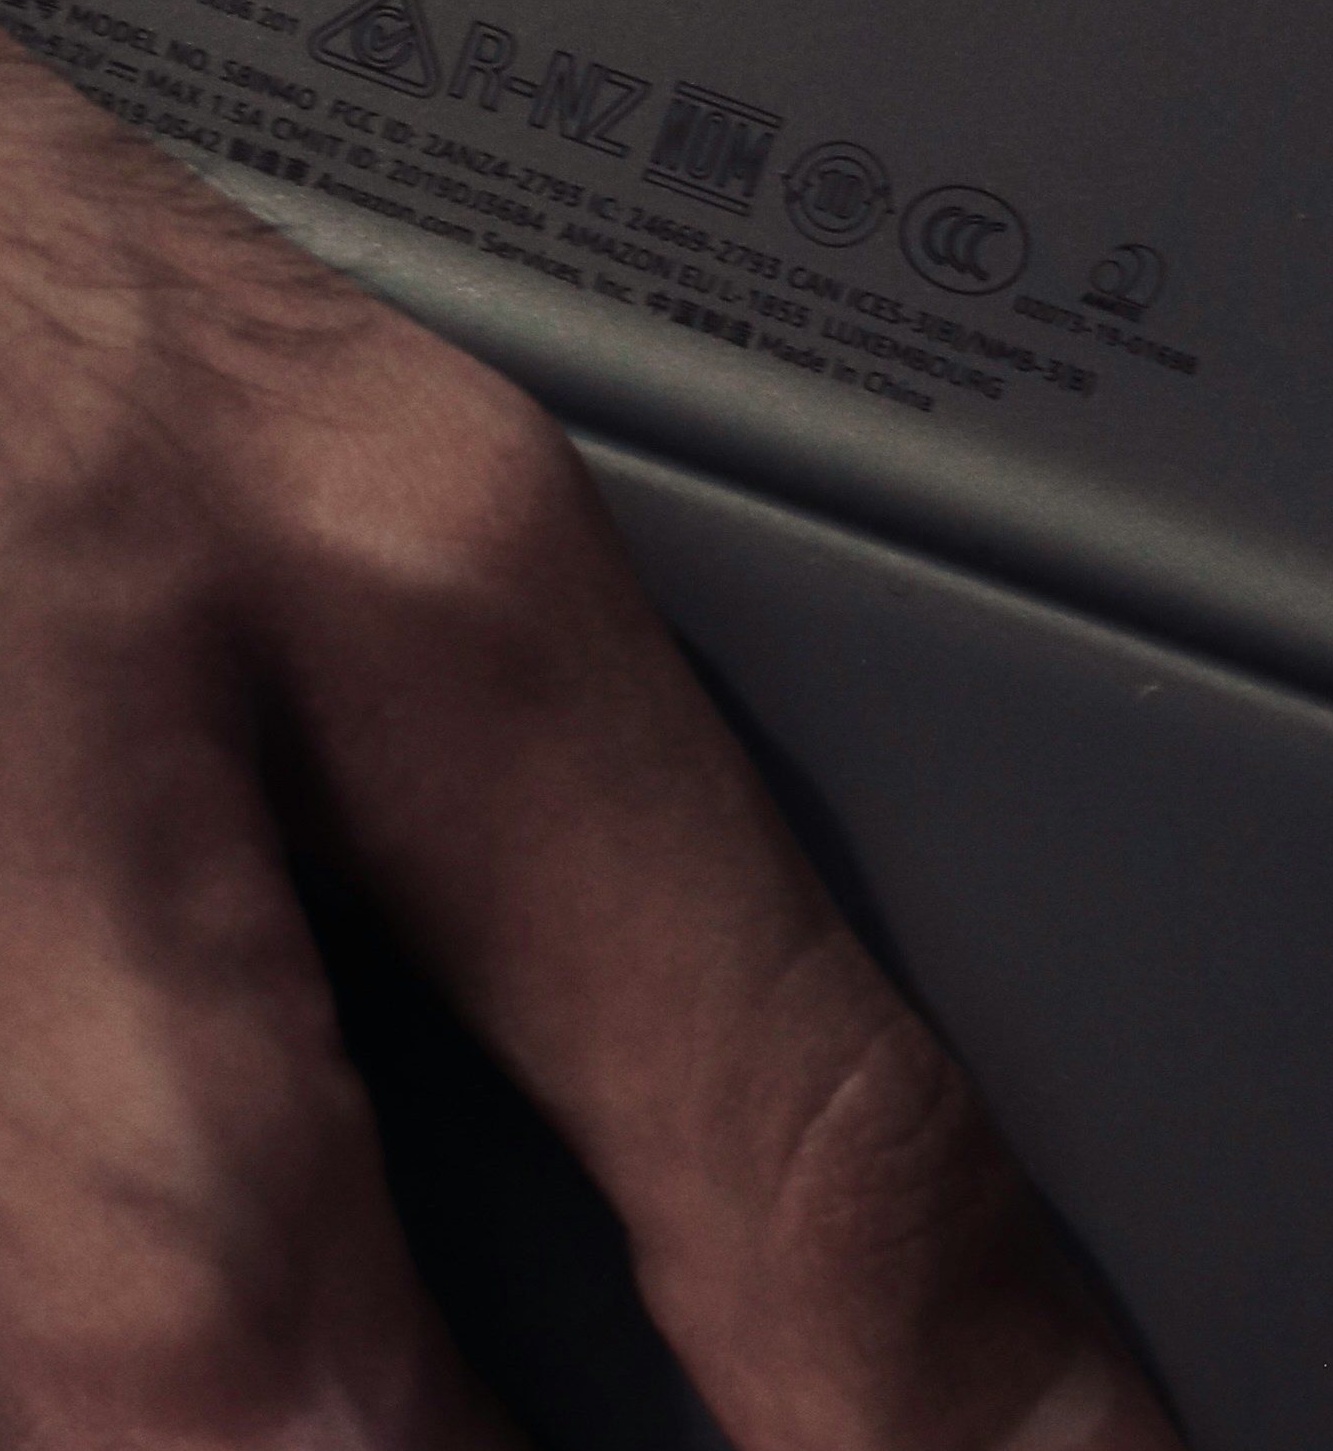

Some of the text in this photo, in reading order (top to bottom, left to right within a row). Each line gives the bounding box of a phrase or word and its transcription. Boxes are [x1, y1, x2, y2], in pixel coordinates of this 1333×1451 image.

[64, 3, 163, 56] MODEL
[329, 97, 381, 135] FCC
[379, 115, 418, 149] ID:
[419, 132, 586, 209] 2ANZ4-2793
[624, 205, 783, 280] 24669-2793
[783, 262, 844, 304] CAN
[445, 18, 655, 160] R-NZ
[648, 95, 776, 199] NOM
[139, 68, 206, 109] MAX
[206, 92, 266, 132] 1.5A
[555, 219, 677, 280] AMAZON
[677, 262, 719, 295] EU
[717, 278, 811, 329] L-1855
[818, 315, 1009, 402] LUXEMBOURG
[310, 168, 478, 246] Amazon.com
[754, 330, 831, 375] Made
[828, 355, 864, 386] in
[859, 366, 940, 415] China
